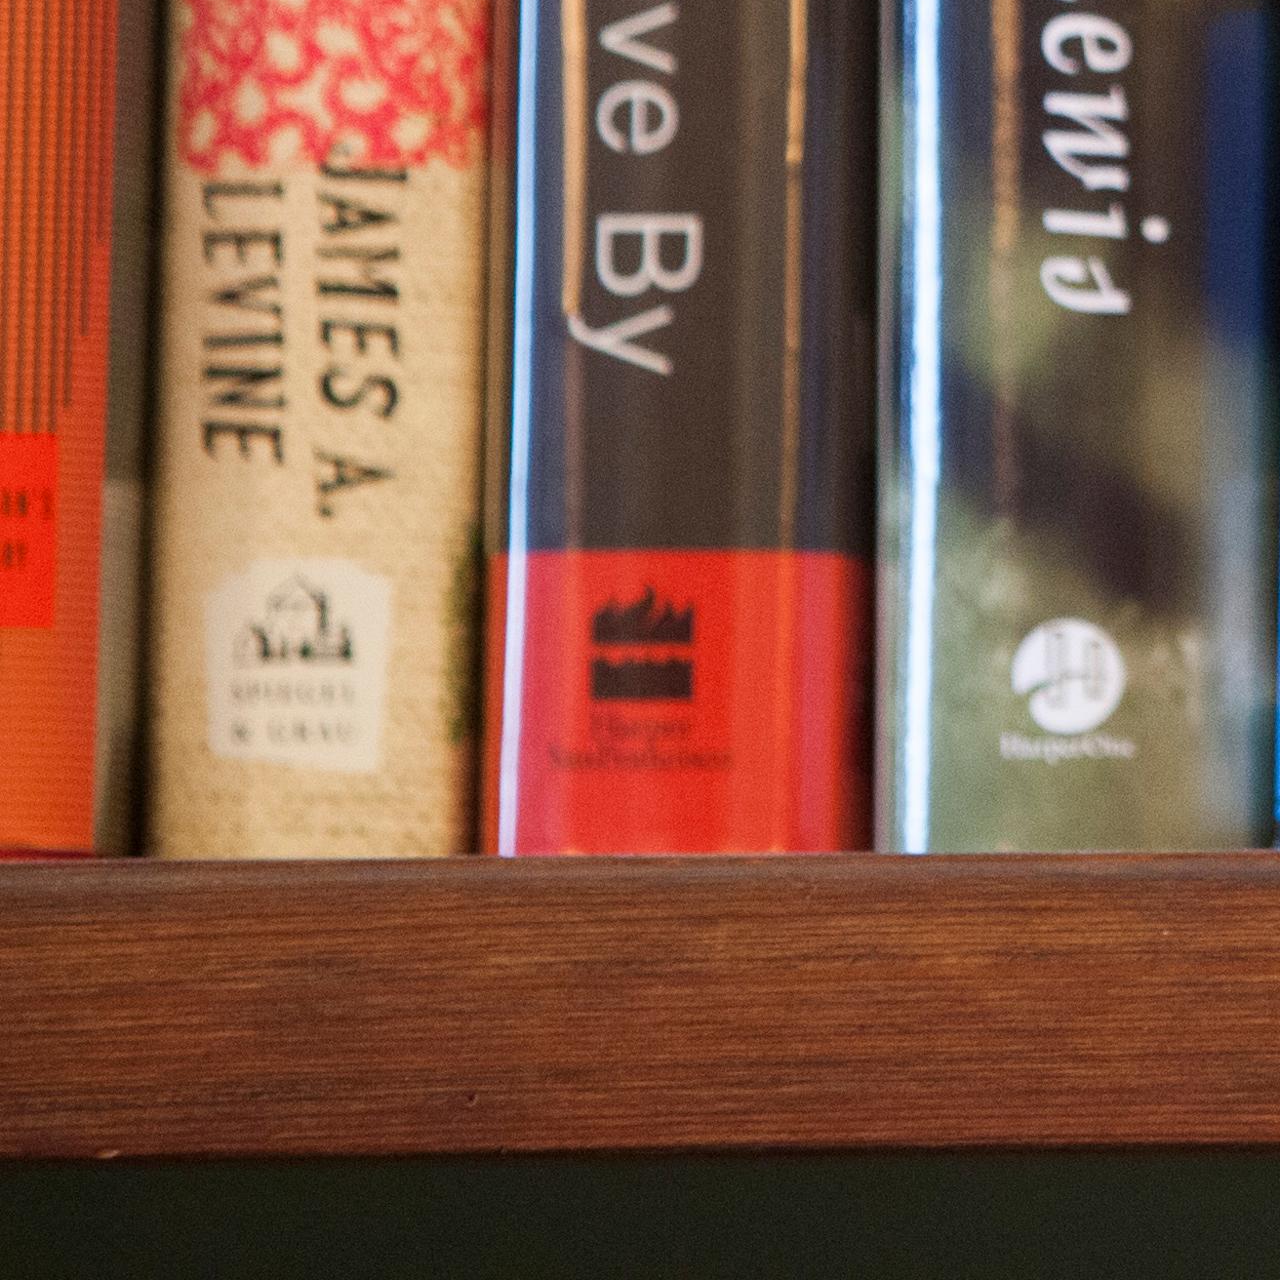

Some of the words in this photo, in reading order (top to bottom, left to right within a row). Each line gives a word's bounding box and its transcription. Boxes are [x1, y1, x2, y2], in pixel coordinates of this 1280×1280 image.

[201, 181, 287, 465] LEVINE
[316, 142, 408, 418] JAMES
[566, 212, 704, 376] By
[316, 444, 397, 519] A.
